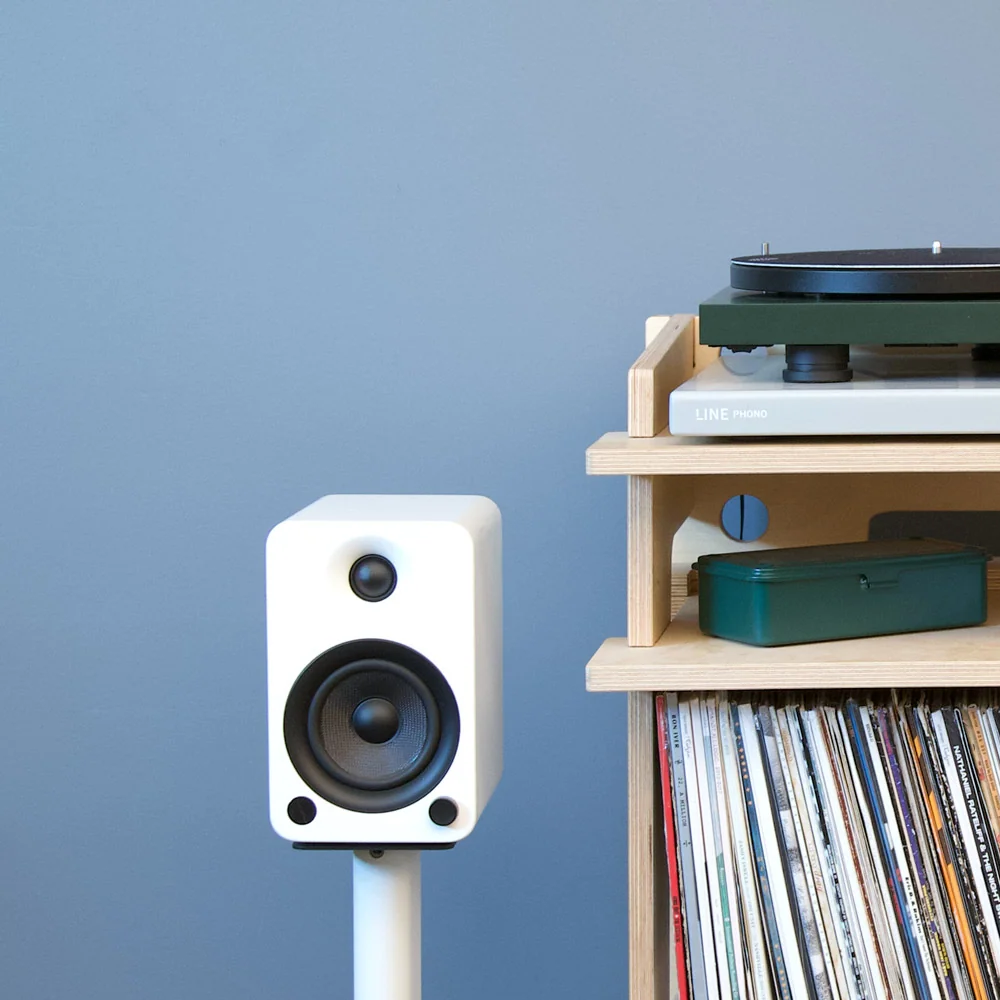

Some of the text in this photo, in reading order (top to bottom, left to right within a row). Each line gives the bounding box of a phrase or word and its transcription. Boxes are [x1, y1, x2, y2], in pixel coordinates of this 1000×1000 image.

[695, 407, 768, 421] LINE PHONO
[952, 744, 973, 799] NATHANIEL
[679, 799, 687, 827] MILLION
[966, 798, 985, 843] RATELIFF
[978, 842, 987, 852] &
[981, 852, 993, 872] THE
[986, 872, 1000, 902] NIGHT
[903, 876, 912, 890] Eric
[911, 907, 923, 933] Rakim
